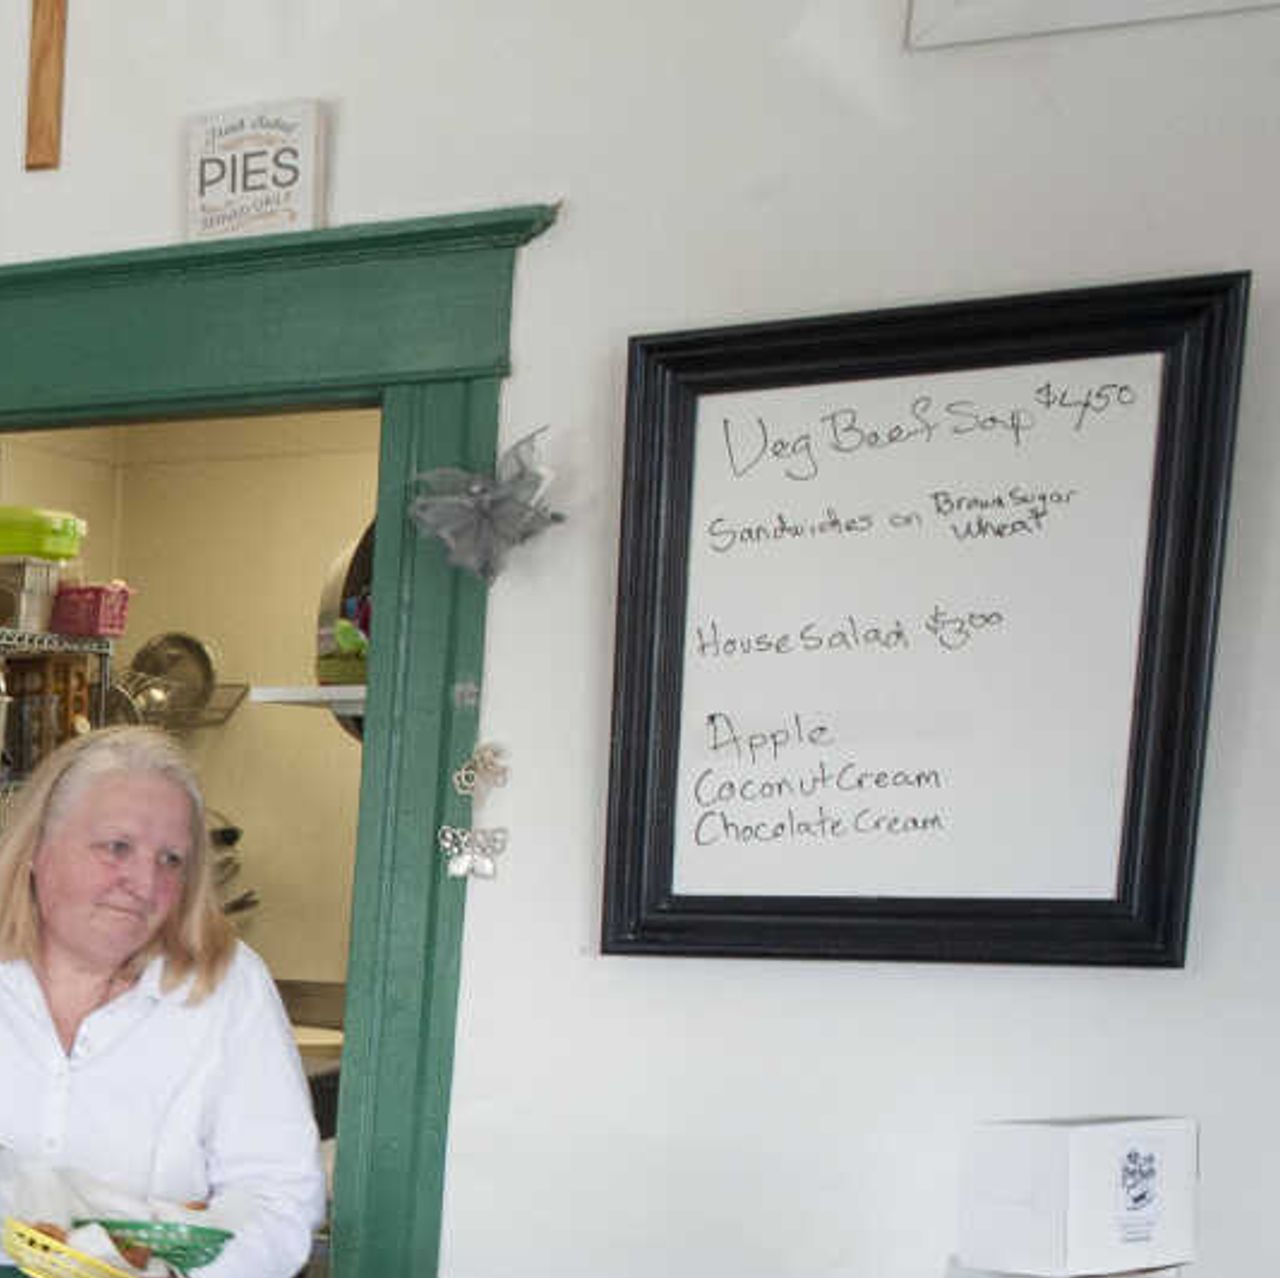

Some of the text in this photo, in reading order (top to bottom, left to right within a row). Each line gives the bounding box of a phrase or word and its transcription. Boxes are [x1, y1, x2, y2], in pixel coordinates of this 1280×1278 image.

[198, 146, 301, 197] PIES
[723, 416, 819, 481] Veg
[708, 507, 874, 553] Sandwiches
[888, 511, 922, 529] on
[697, 618, 793, 658] House
[800, 614, 909, 655] Salad
[705, 712, 837, 766] Apple
[693, 761, 943, 809] Coconut Cream
[693, 806, 945, 847] Chocolate Cream
